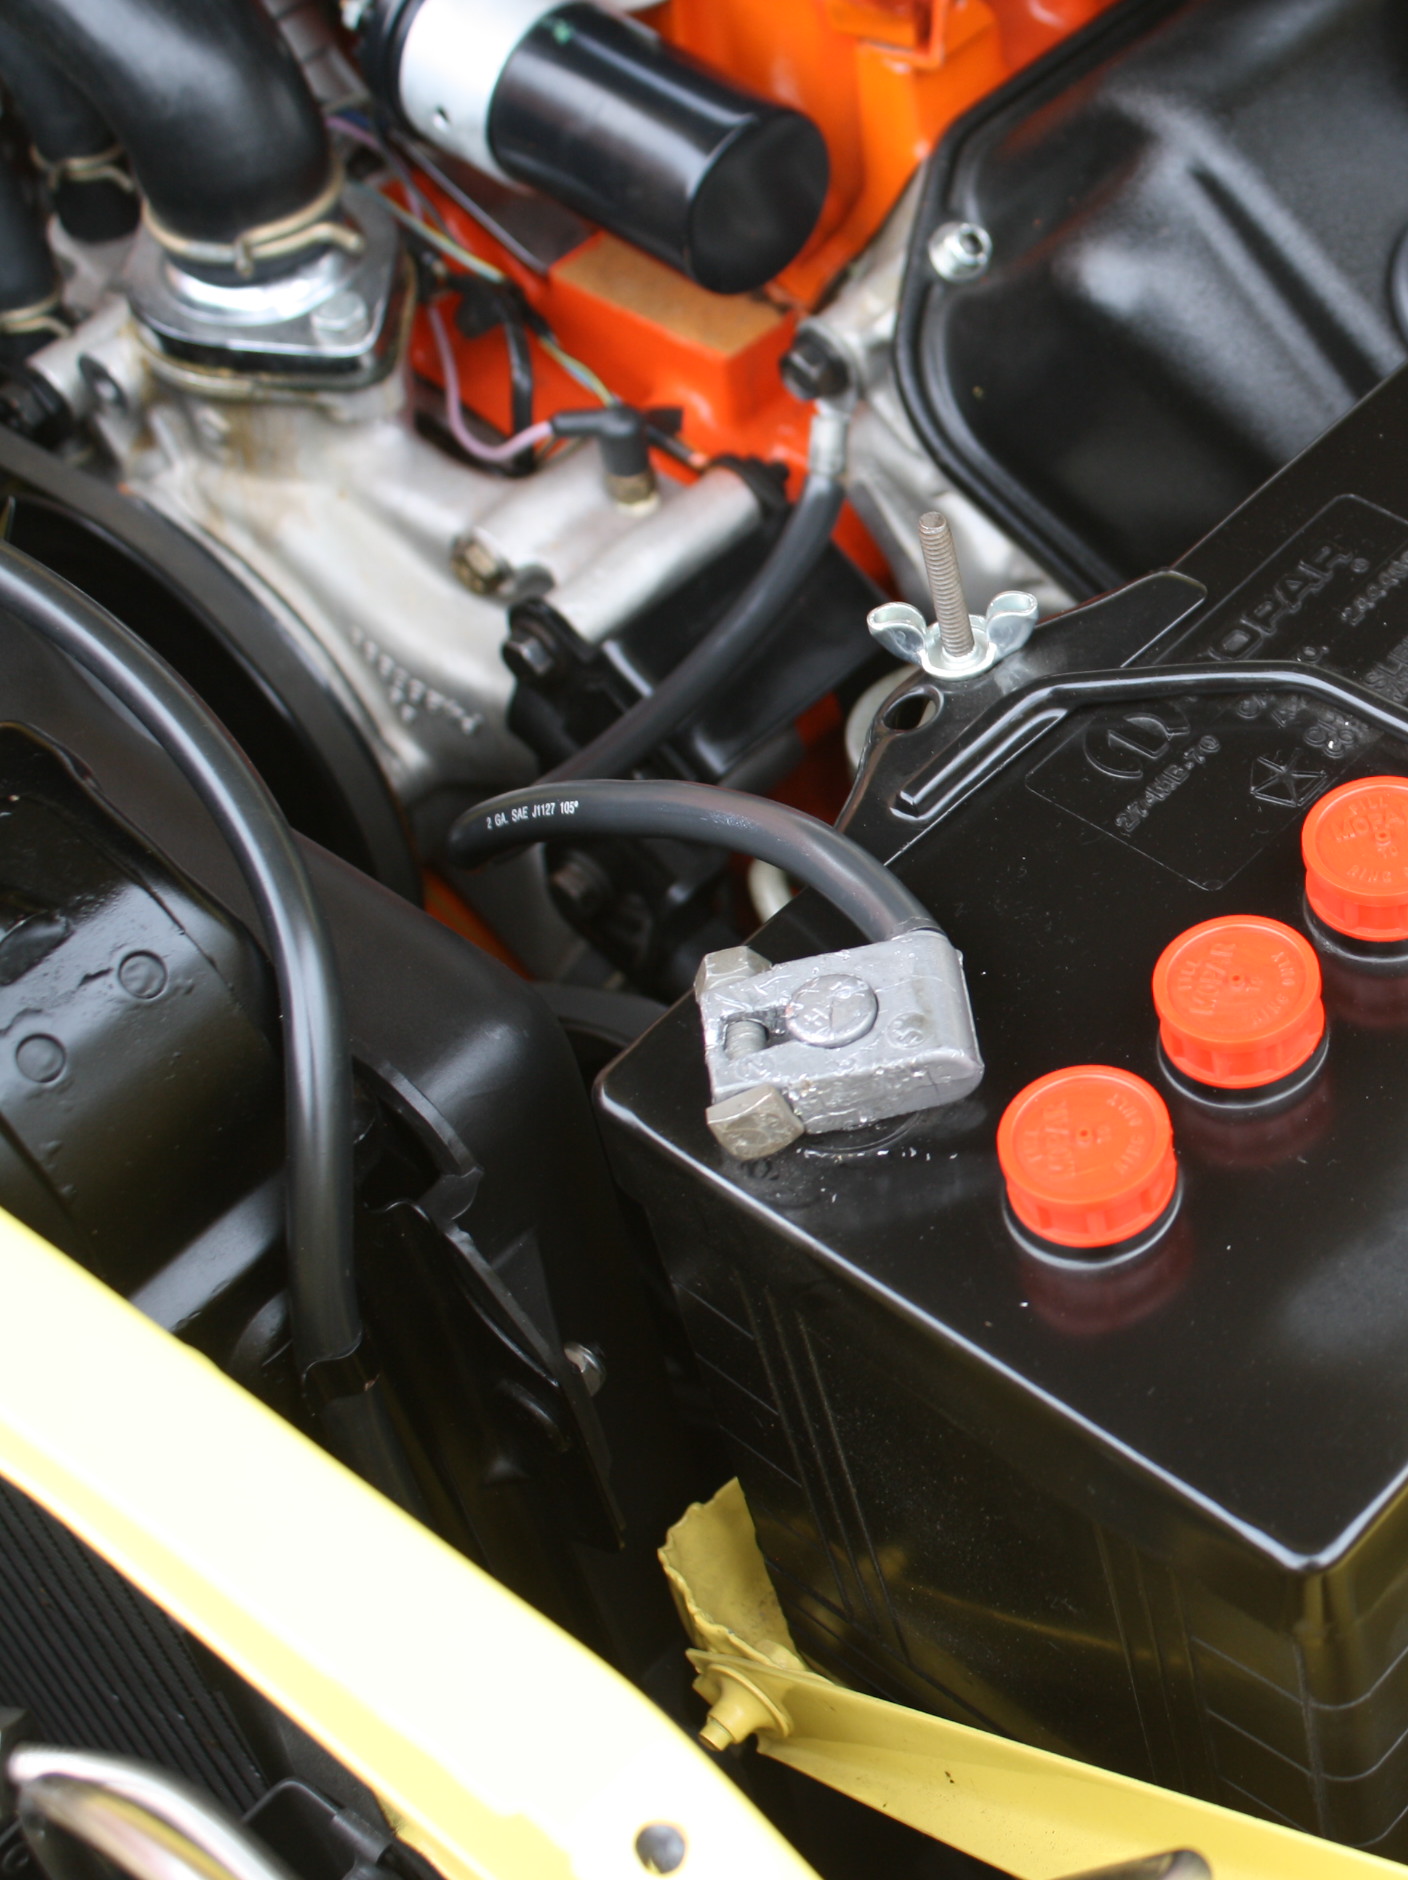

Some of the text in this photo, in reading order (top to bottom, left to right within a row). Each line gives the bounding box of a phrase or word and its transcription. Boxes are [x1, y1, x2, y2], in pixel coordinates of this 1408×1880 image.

[511, 806, 528, 823] SAE
[532, 803, 555, 818] J1127
[1348, 795, 1388, 816] FILL
[1346, 865, 1392, 882] RING
